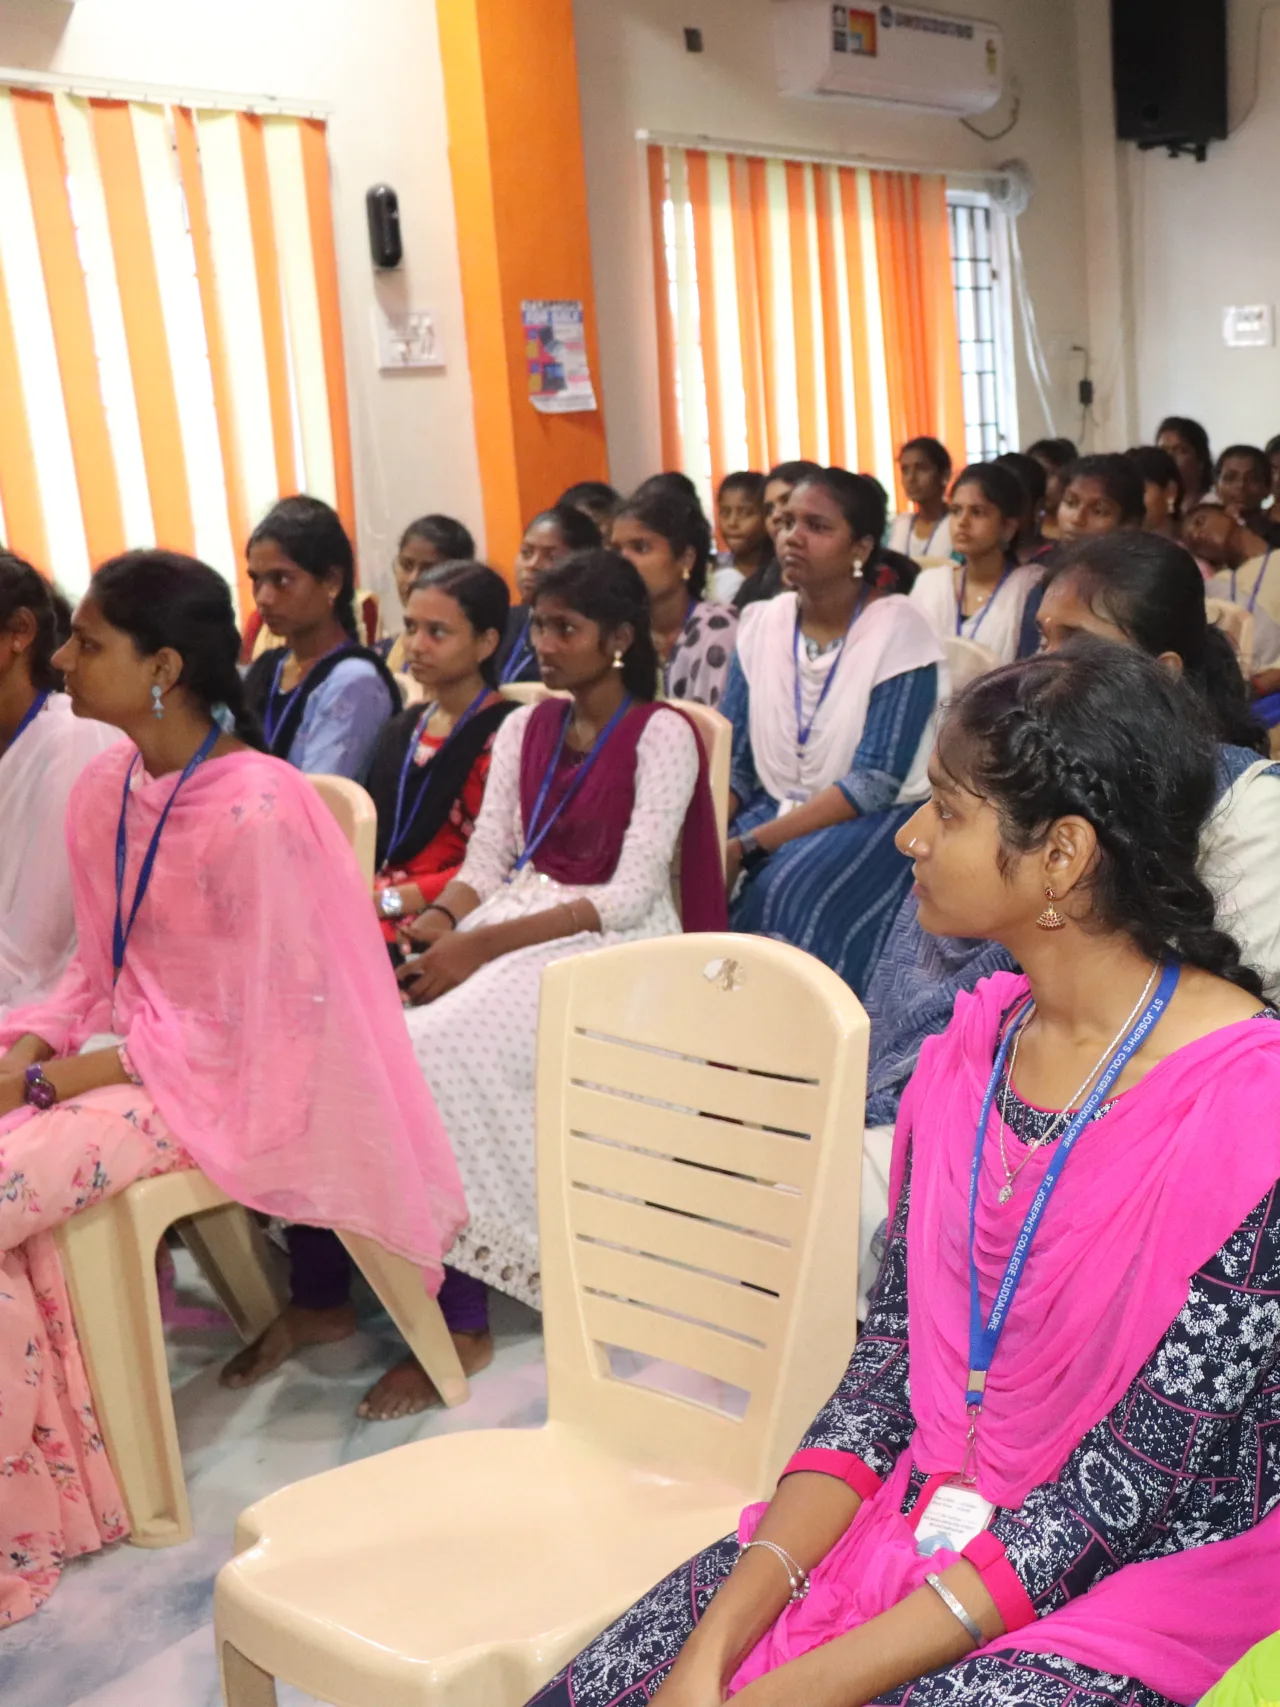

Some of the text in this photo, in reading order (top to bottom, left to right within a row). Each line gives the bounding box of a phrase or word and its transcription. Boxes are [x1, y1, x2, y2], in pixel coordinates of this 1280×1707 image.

[1062, 998, 1164, 1149] ST. JOSEPH'S COLLEGE CUDDALORE
[987, 1174, 1054, 1332] ST. JOSEPH'S COLLEGE CUDDALORE
